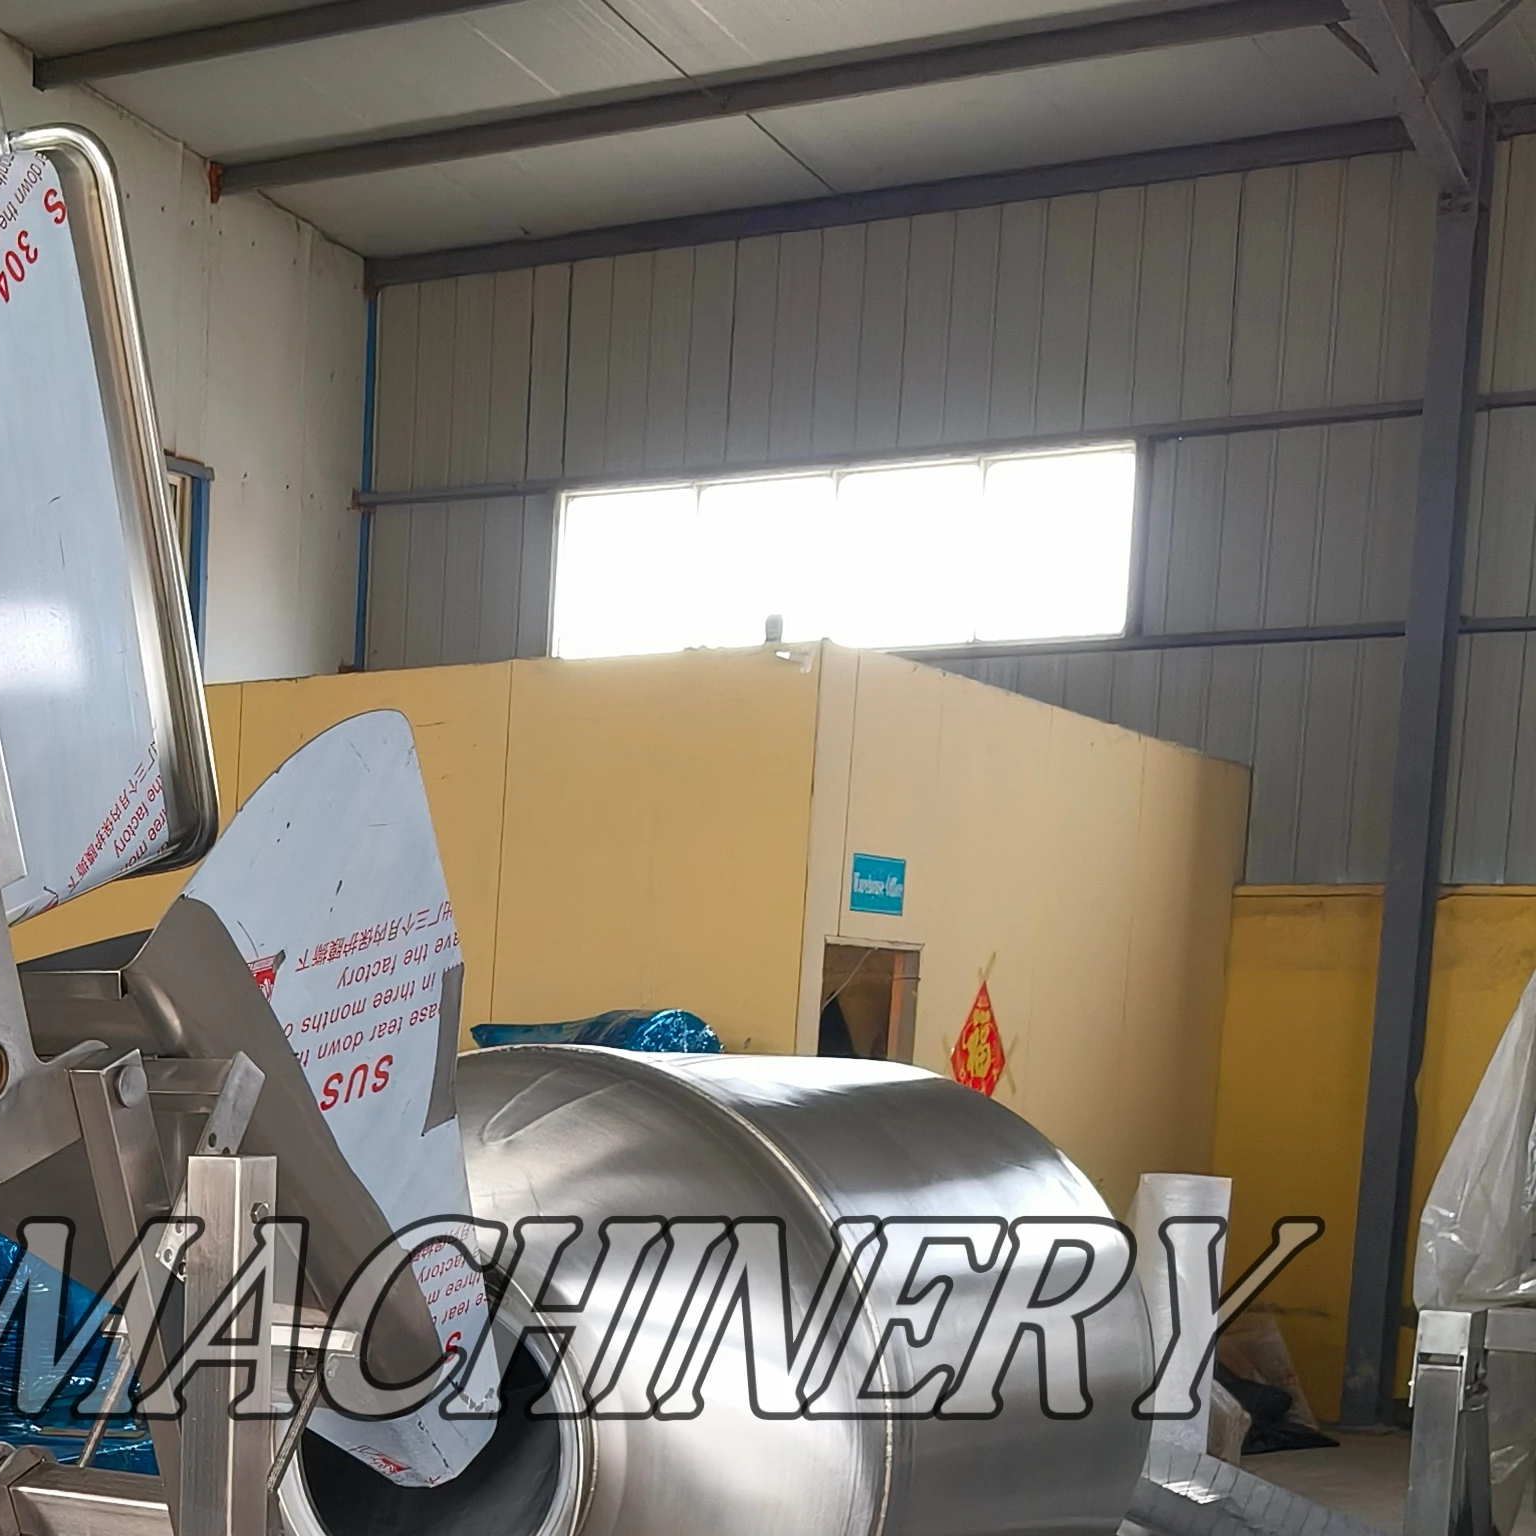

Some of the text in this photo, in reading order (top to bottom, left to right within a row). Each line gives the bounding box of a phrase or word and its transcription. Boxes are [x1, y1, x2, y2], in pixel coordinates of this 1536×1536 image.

[14, 163, 43, 203] down
[114, 802, 149, 858] factory
[403, 943, 429, 964] the
[337, 954, 398, 989] factory
[422, 972, 436, 991] in
[373, 980, 415, 1008] three
[301, 997, 367, 1033] months
[370, 1017, 402, 1041] tear
[318, 1031, 363, 1059] down
[320, 1054, 393, 1111] SUS
[442, 1300, 469, 1325] tear
